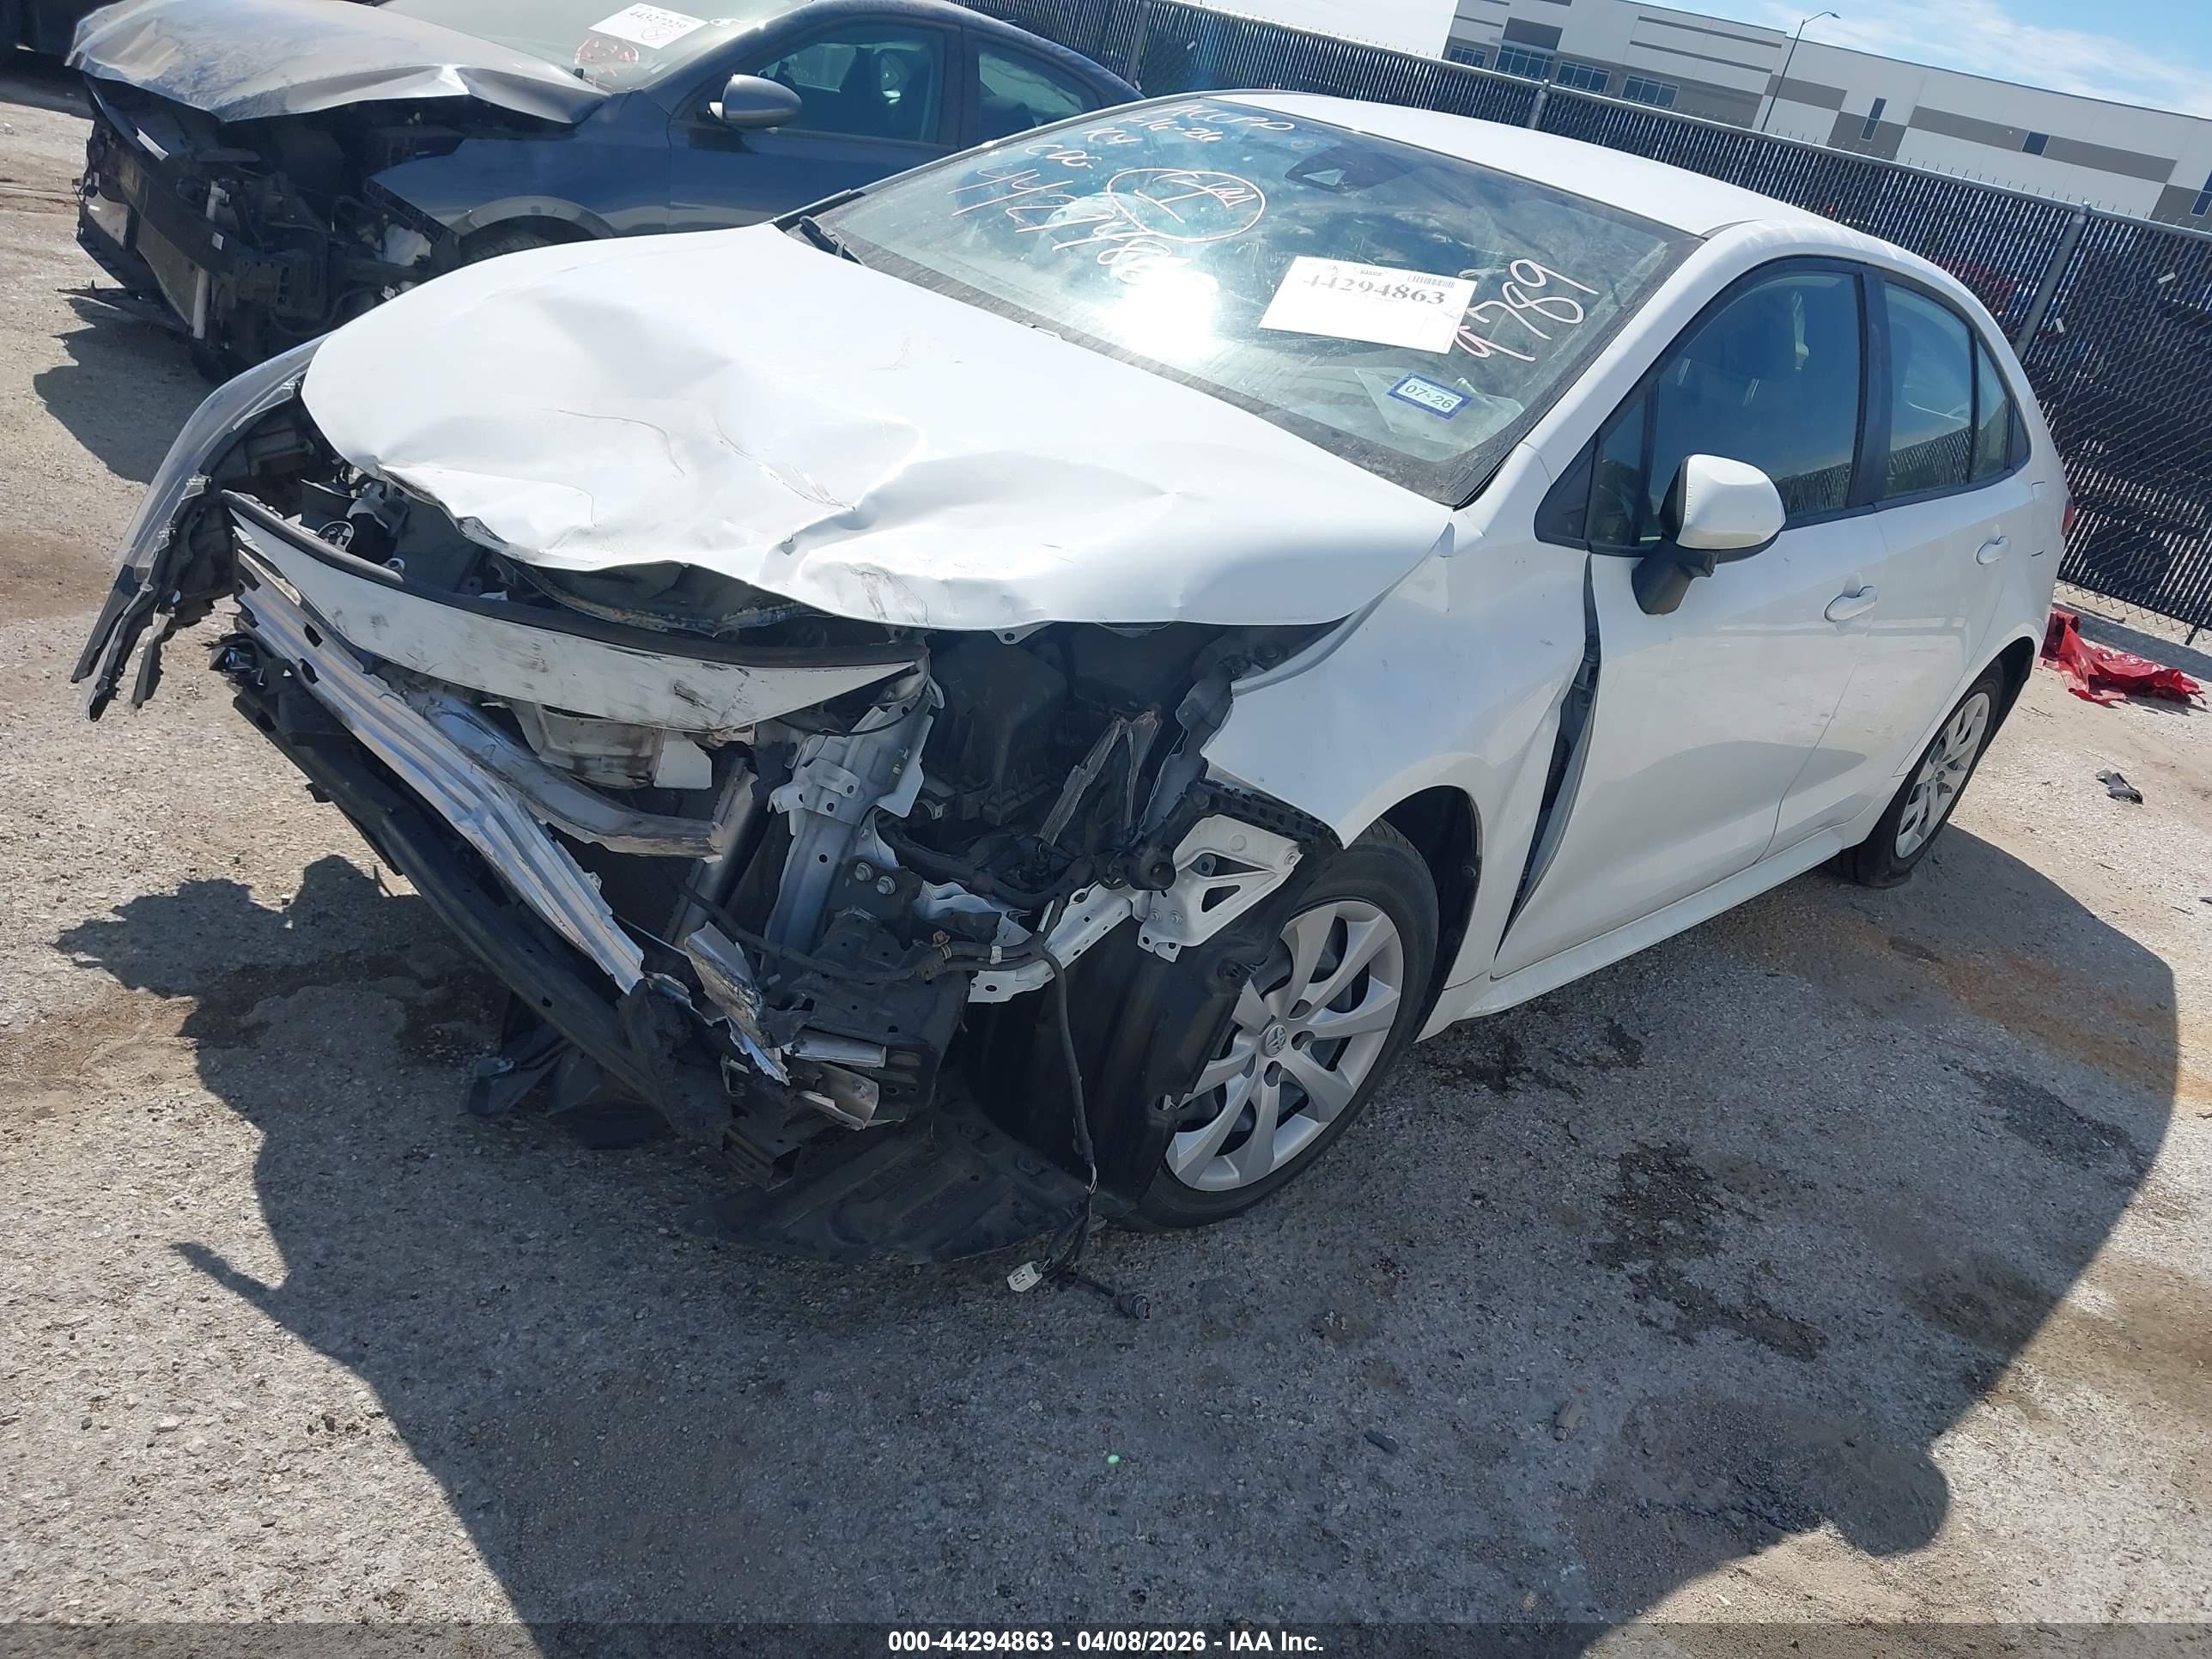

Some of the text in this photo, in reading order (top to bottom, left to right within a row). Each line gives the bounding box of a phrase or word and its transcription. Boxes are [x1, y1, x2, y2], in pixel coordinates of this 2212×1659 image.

[1304, 274, 1446, 305] 44294863
[1405, 384, 1429, 397] 07
[1431, 395, 1455, 409] 26
